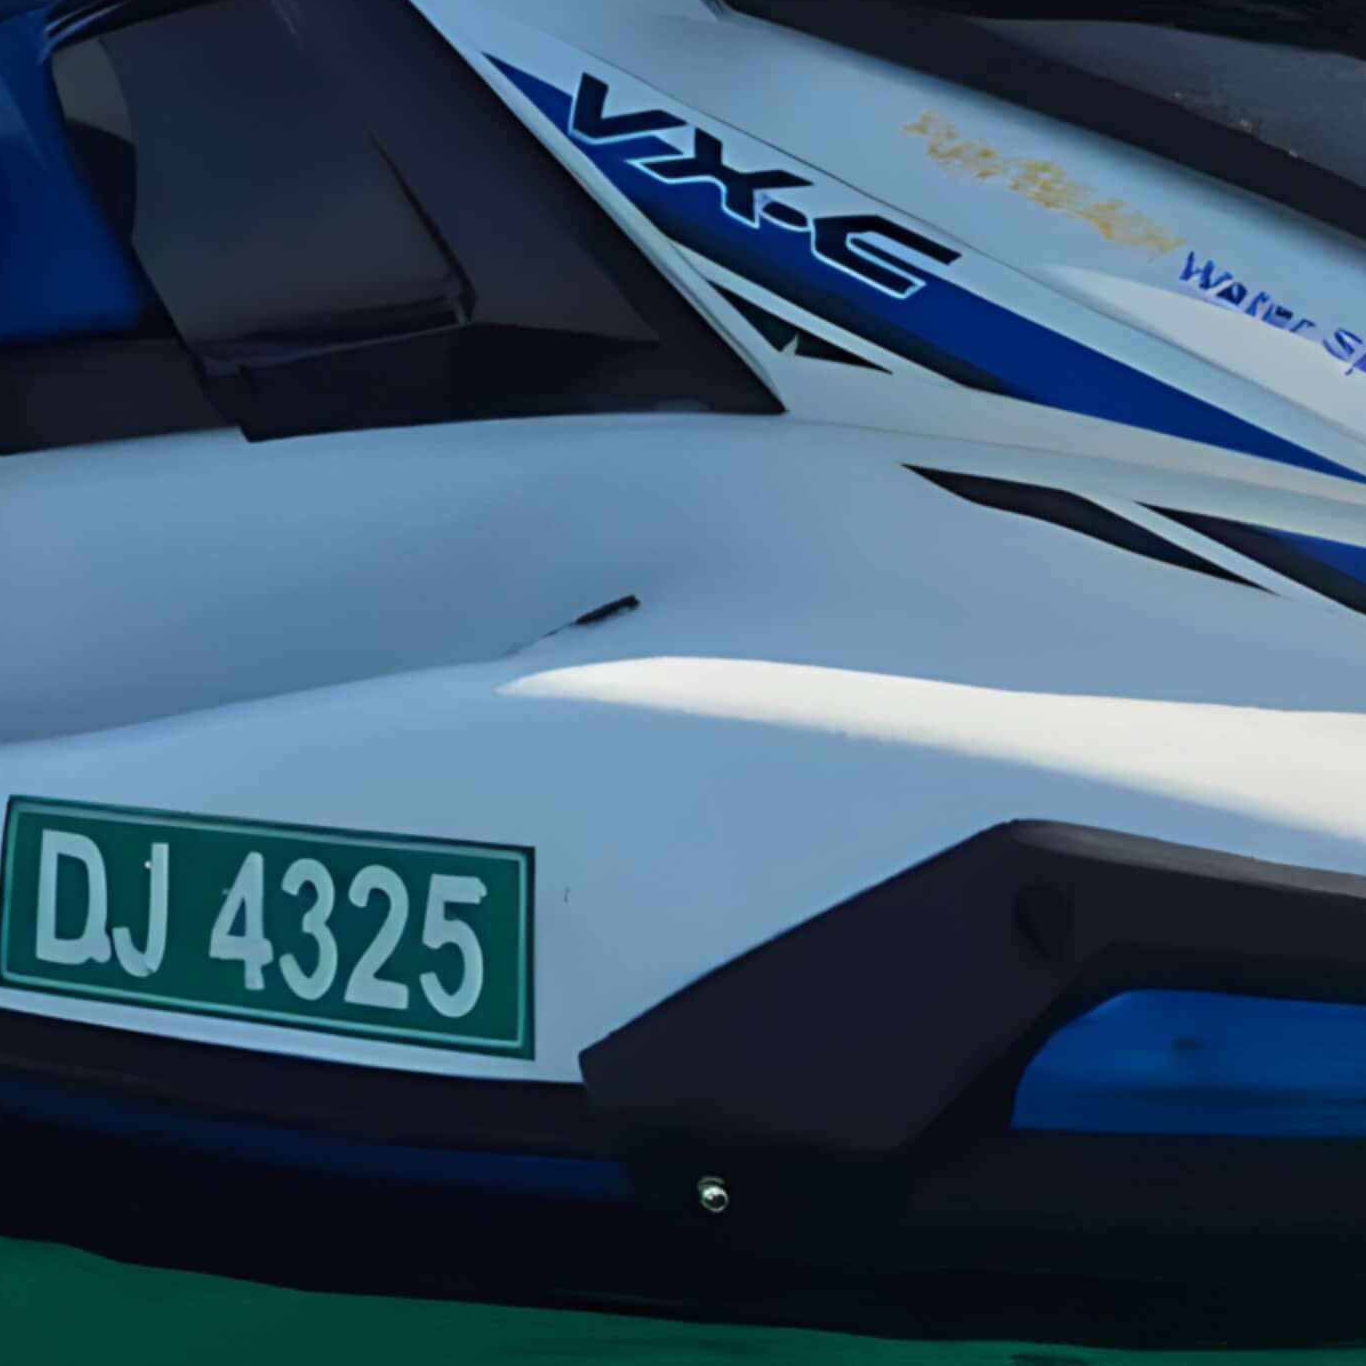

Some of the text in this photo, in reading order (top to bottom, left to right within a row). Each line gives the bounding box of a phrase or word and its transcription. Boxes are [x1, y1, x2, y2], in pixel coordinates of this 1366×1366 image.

[1179, 250, 1317, 333] Water
[35, 829, 488, 1018] DJ 4325
